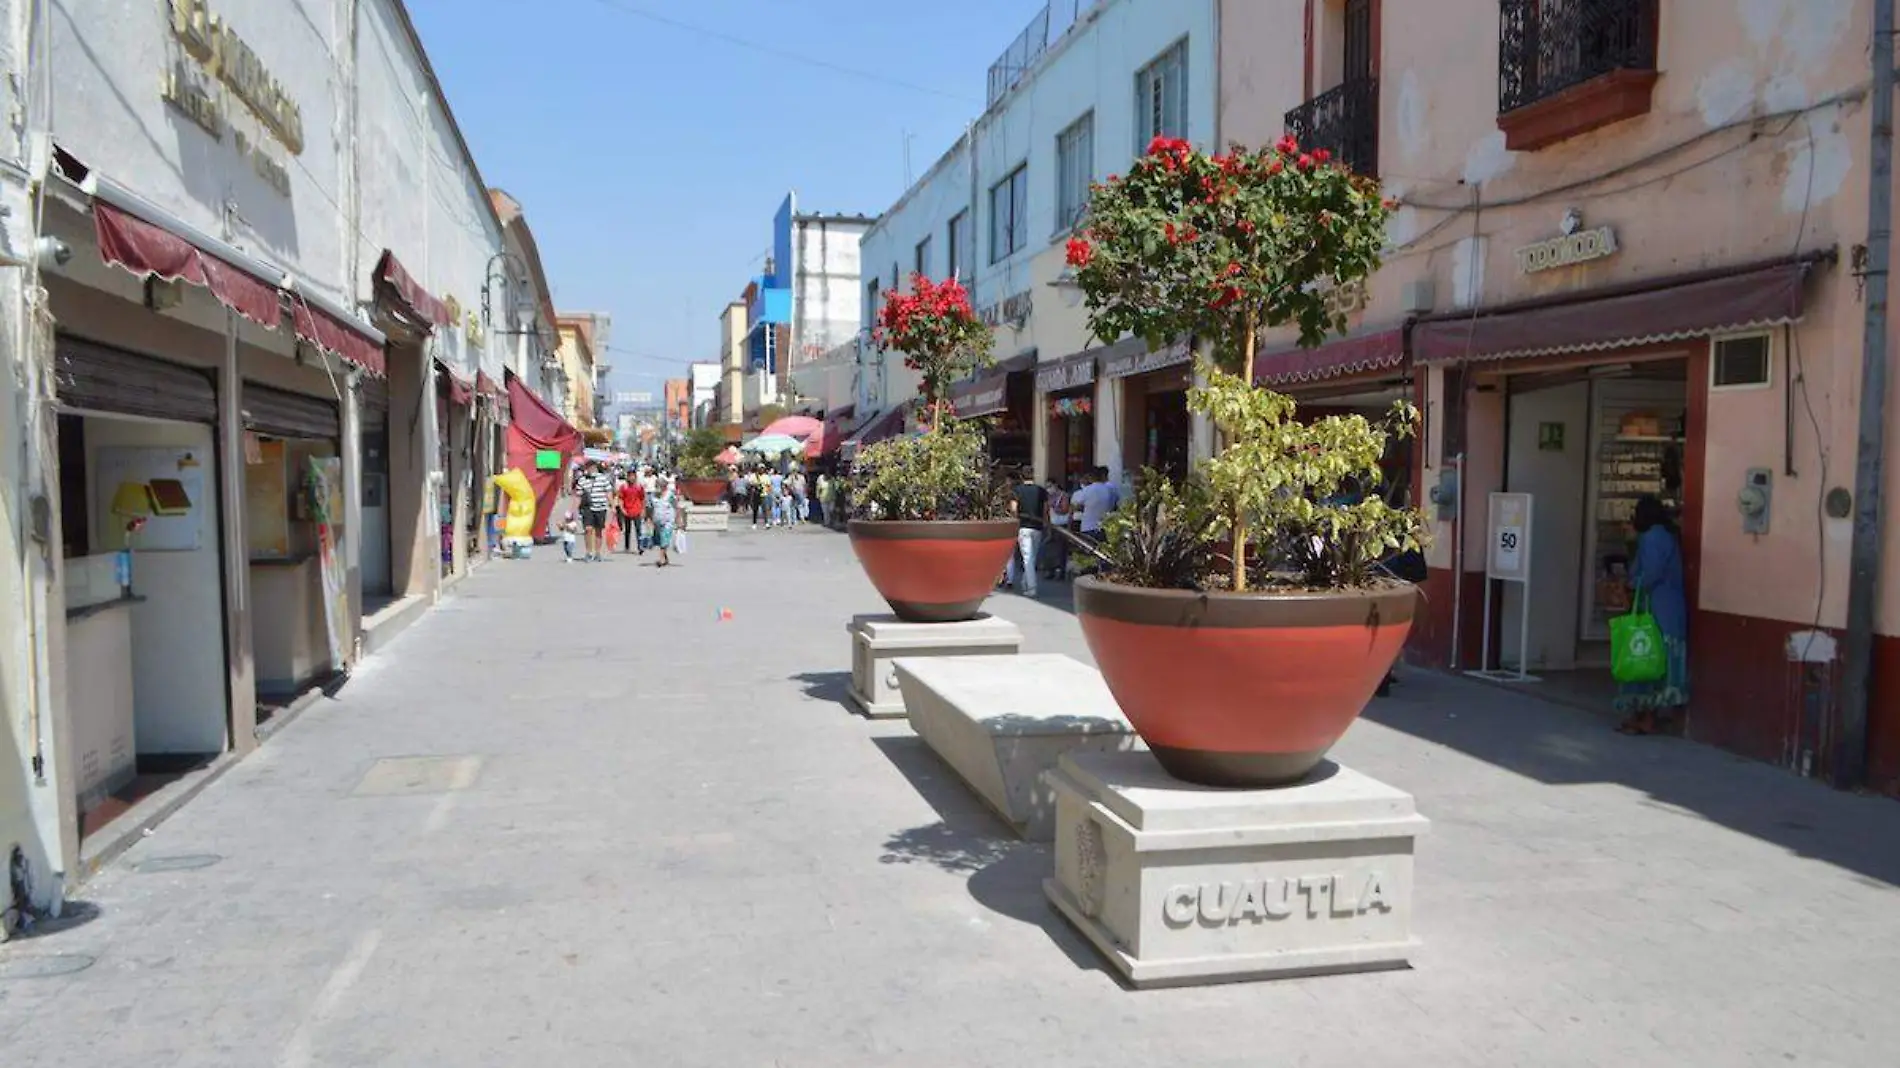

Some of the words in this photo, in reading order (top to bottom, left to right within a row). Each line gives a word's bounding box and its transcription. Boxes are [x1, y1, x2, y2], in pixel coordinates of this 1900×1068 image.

[1515, 226, 1617, 274] TODOMODA
[1501, 532, 1517, 548] 50
[1162, 871, 1392, 929] CUAUTLA
